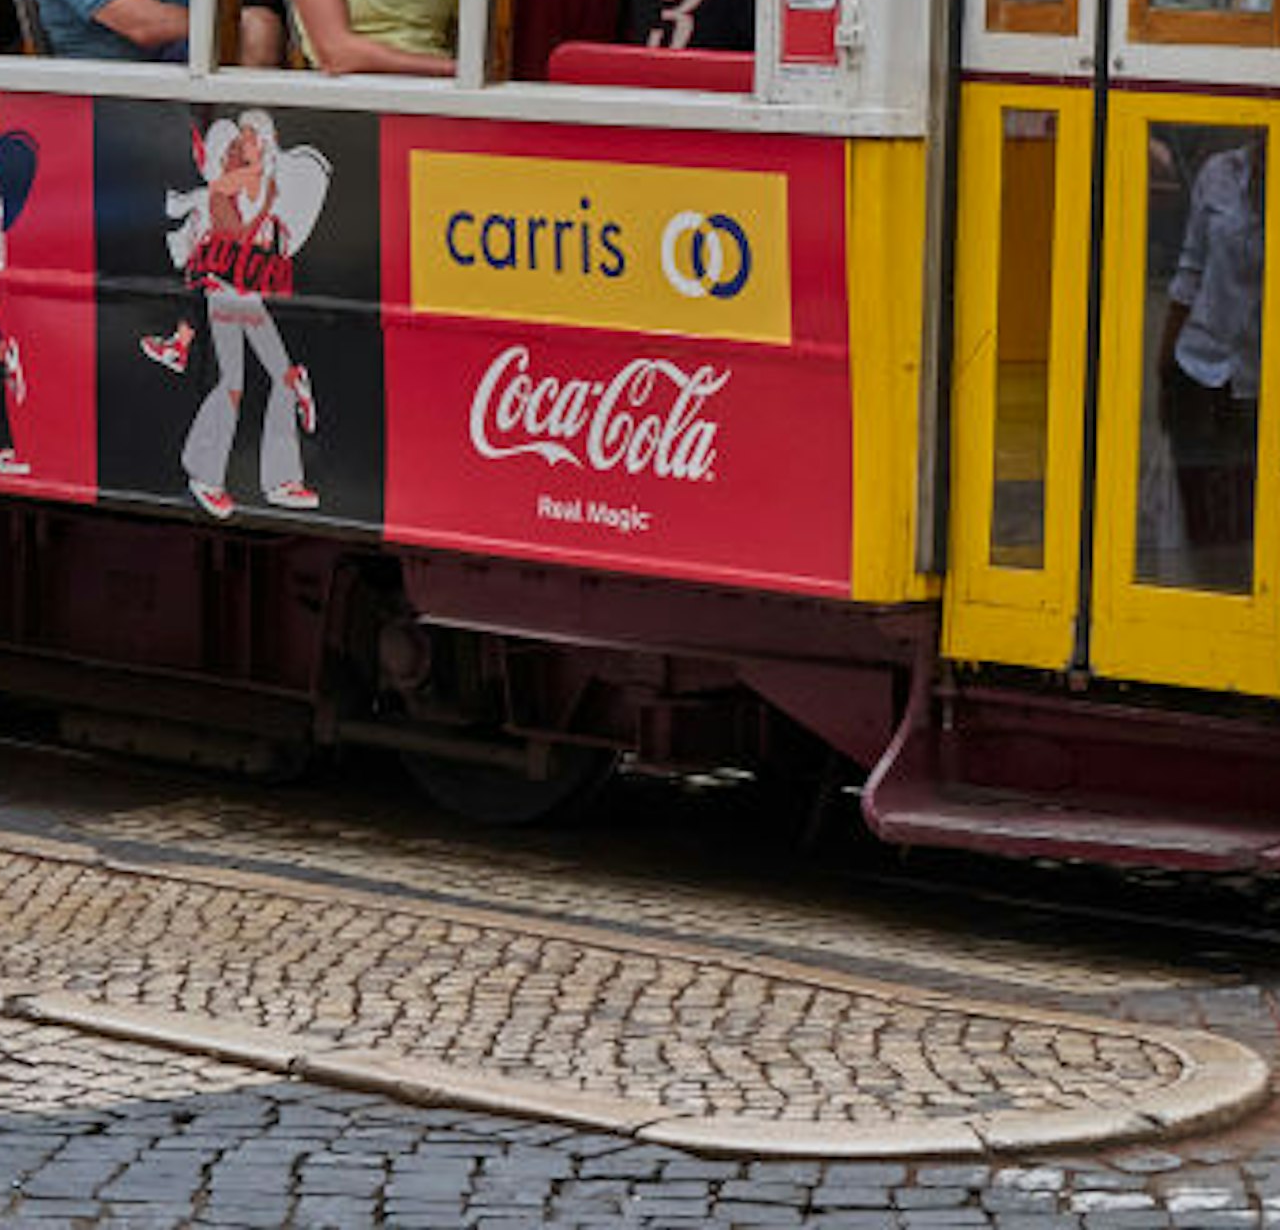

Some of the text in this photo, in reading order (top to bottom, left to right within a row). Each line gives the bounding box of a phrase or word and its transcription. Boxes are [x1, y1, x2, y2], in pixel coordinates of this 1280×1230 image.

[445, 197, 626, 278] carris
[469, 343, 732, 482] Coca-Cola
[537, 495, 651, 531] Real Magic
